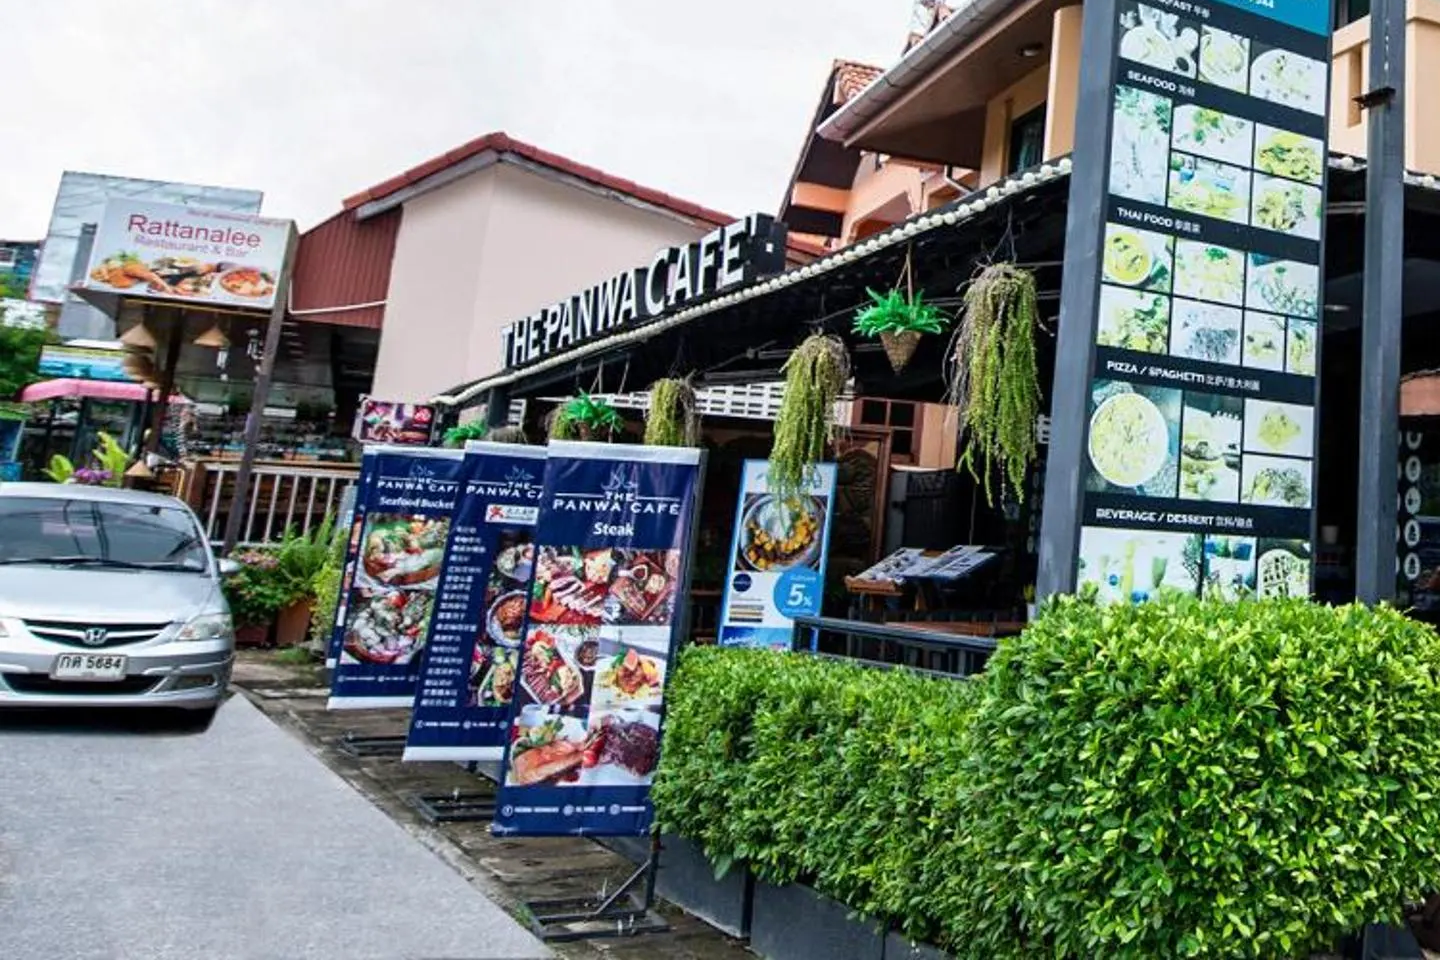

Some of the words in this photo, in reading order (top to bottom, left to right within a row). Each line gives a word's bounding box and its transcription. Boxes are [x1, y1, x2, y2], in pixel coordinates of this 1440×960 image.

[1127, 70, 1176, 91] SEAFOOD
[1117, 207, 1142, 221] THAI
[1144, 212, 1173, 228] FOOD
[128, 214, 261, 248] Rattanalee
[501, 313, 545, 368] THE
[545, 269, 638, 353] PANWA
[1107, 361, 1138, 374] PIZZA
[1148, 367, 1205, 383] SPAGHETTI
[377, 481, 424, 491] PANWA
[430, 483, 459, 493] CAF
[466, 485, 521, 498] PANWA
[507, 481, 531, 490] THE
[379, 496, 421, 508] Seafood
[604, 491, 635, 501] THE
[553, 499, 621, 512] PANWA
[1096, 508, 1157, 522] BEVERAGE
[1166, 513, 1214, 526] DESSERT
[593, 521, 634, 536] Steak
